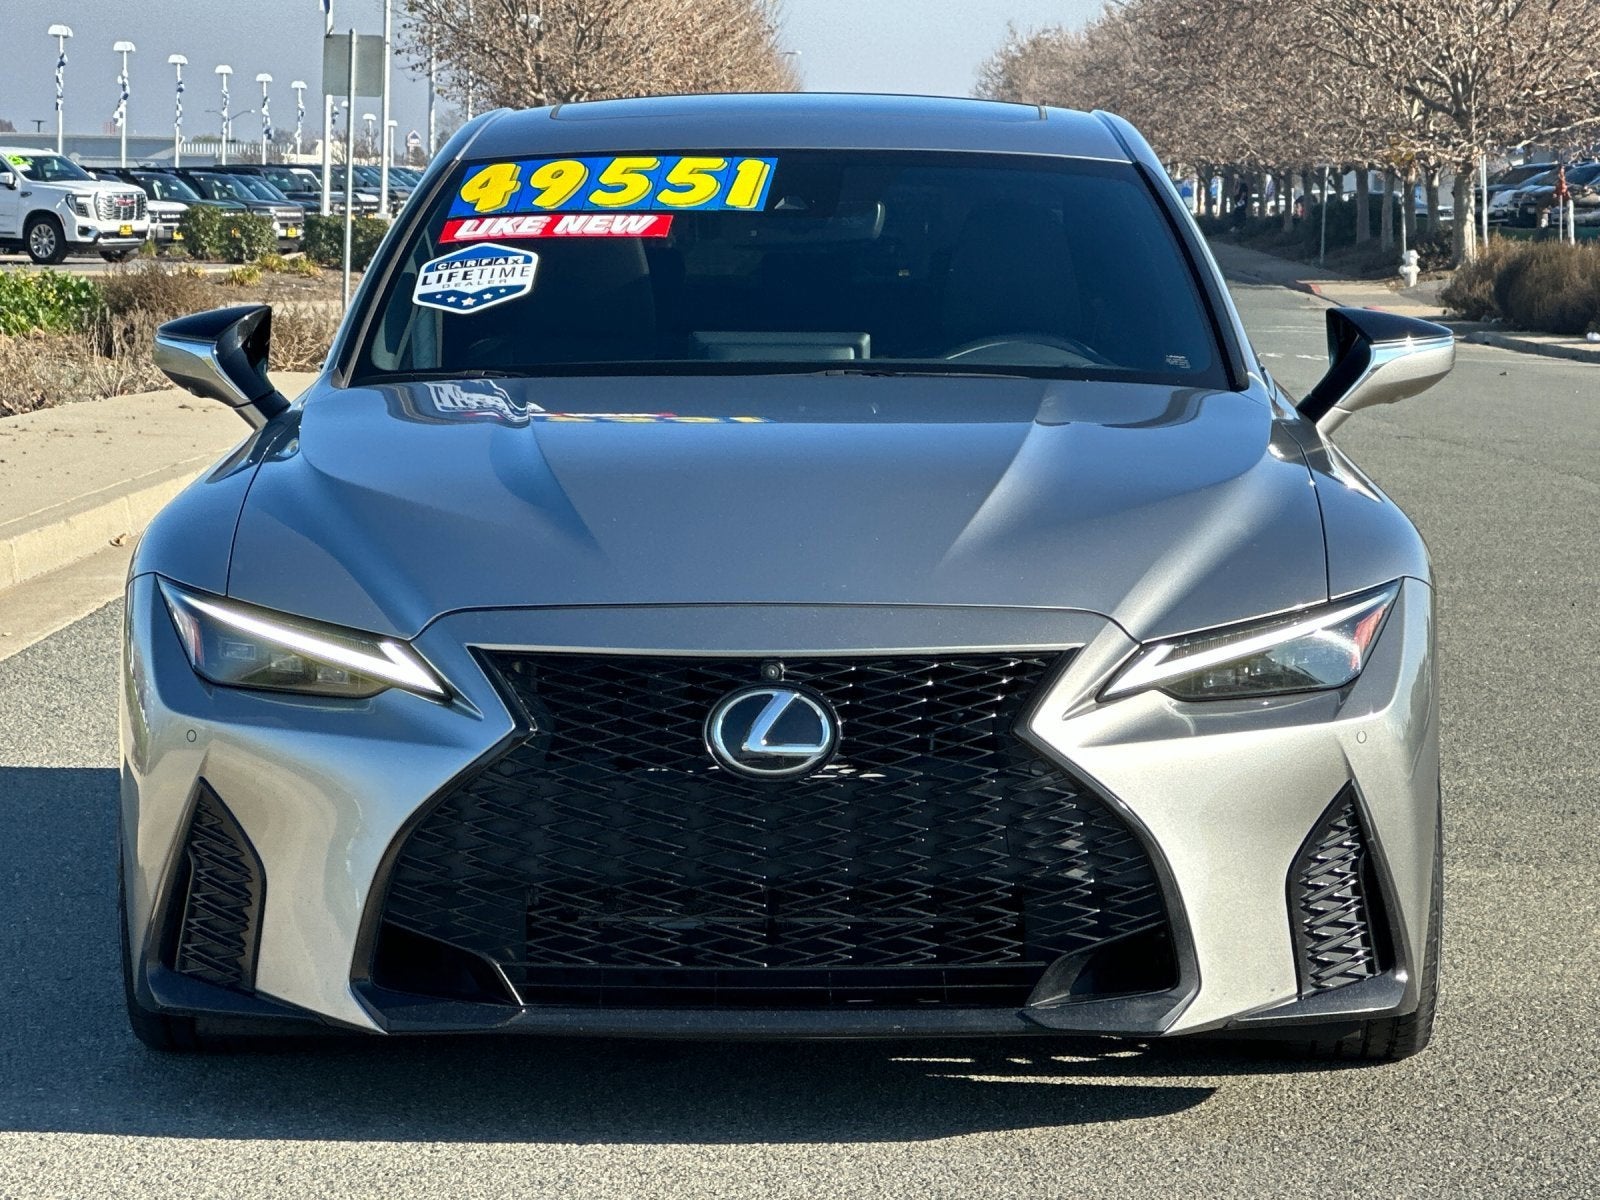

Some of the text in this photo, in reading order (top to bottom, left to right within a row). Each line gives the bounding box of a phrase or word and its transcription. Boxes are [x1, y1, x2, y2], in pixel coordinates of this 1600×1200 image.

[459, 157, 771, 213] 49551
[454, 214, 659, 239] LIKE NEW
[436, 257, 523, 271] CARFAX
[421, 265, 531, 286] LIFETIME
[442, 279, 507, 289] DEALER
